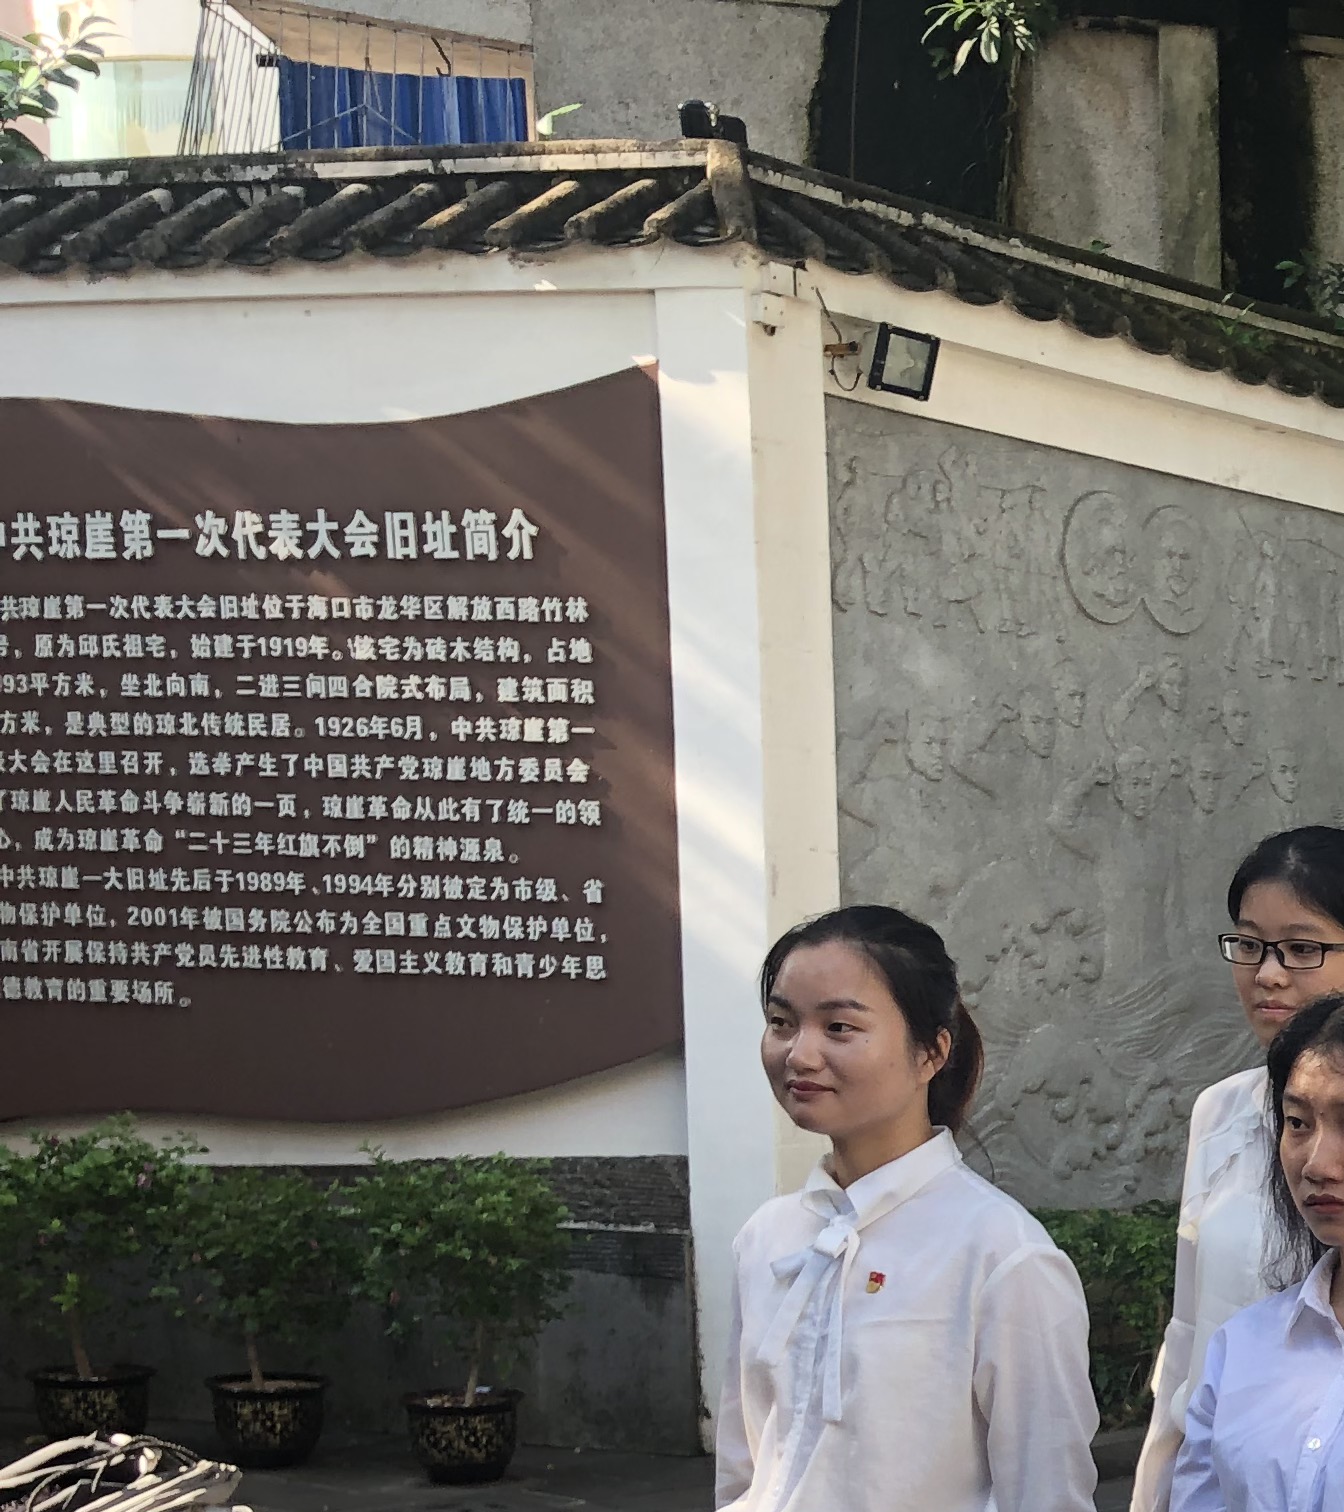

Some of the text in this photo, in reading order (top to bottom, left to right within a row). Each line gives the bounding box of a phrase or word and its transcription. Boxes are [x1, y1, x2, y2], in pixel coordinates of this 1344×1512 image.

[0, 508, 540, 561] 共琼崖第一次代表大会旧址简介
[0, 671, 595, 704] 93平方米，坐北向南，二进三间四合院式布局，建筑面积
[0, 748, 591, 783] 大会在这里召开，选举产生了中国共产党琼崖地方委员会
